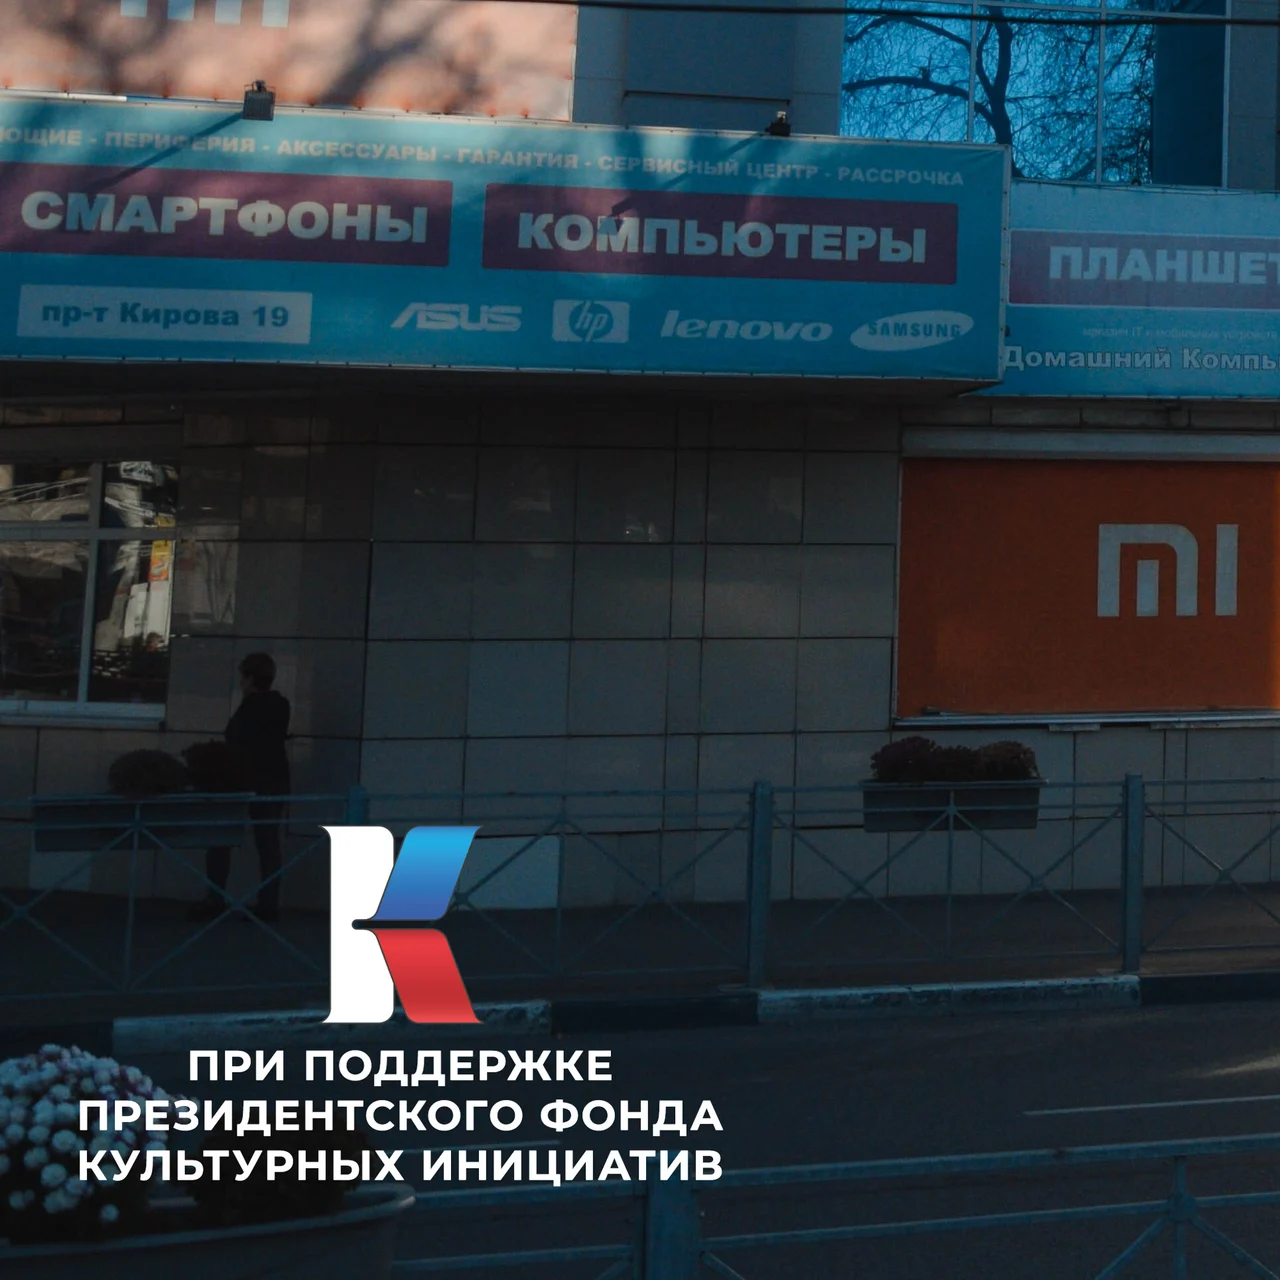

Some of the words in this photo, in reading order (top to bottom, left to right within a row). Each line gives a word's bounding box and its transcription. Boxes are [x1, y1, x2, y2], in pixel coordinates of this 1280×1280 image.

[105, 131, 256, 153] ПЕРИФЕРИЯ
[277, 139, 437, 162] АКСЕССУАРЫ
[457, 147, 578, 169] ГАРАНТИЯ
[598, 154, 739, 177] СЕРВИСНЫЙ
[746, 163, 819, 181] ЦЕНТР
[837, 166, 965, 187] РАССРОЧКА
[20, 190, 428, 244] СМАРТФОНЫ
[518, 212, 927, 263] КОМПЬЮТЕРЫ
[42, 303, 108, 328] пр-т
[119, 301, 241, 330] Кирова
[253, 305, 289, 328] 19
[390, 301, 523, 332] ASUS
[660, 309, 834, 342] lenovo
[867, 322, 962, 338] SAMSUNG
[1003, 345, 1171, 372] Домашний
